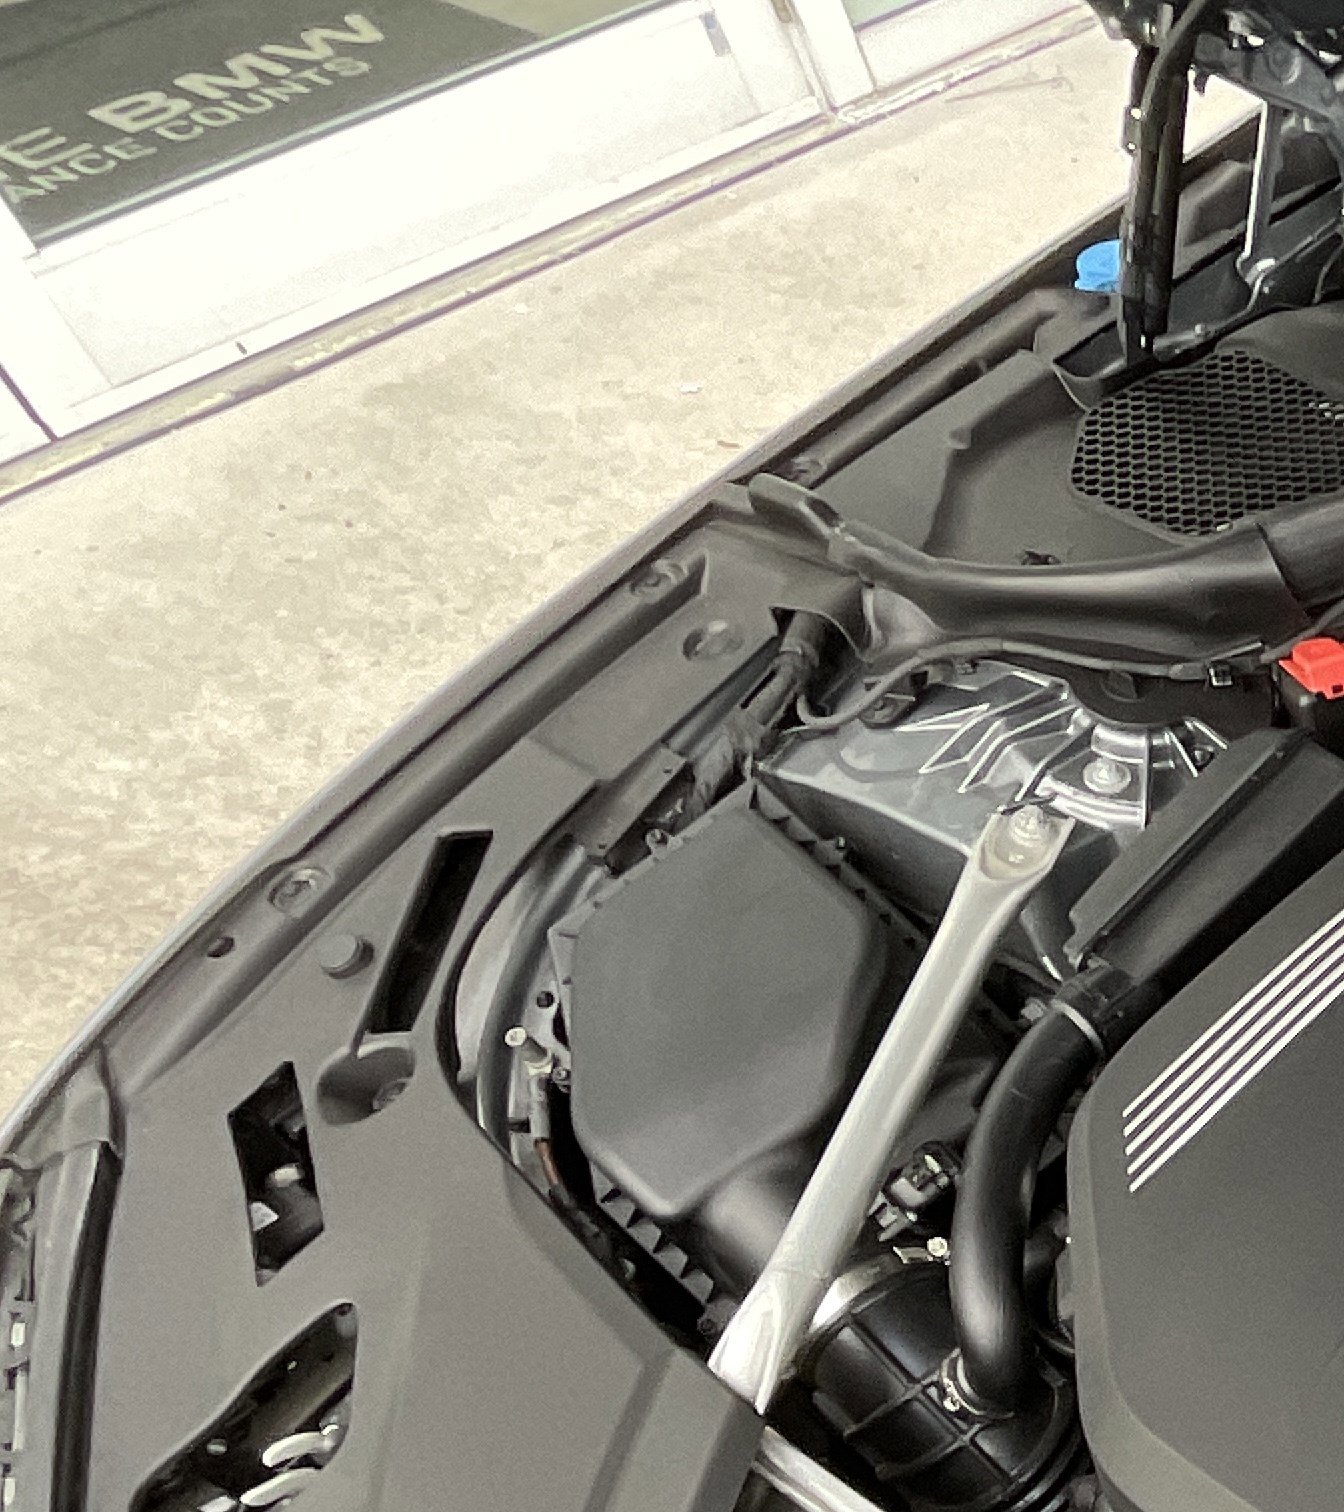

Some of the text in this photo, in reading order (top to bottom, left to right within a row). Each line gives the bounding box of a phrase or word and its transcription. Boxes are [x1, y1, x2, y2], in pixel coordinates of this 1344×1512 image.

[0, 57, 371, 203] ANCE COUNTS
[87, 14, 385, 133] BMW
